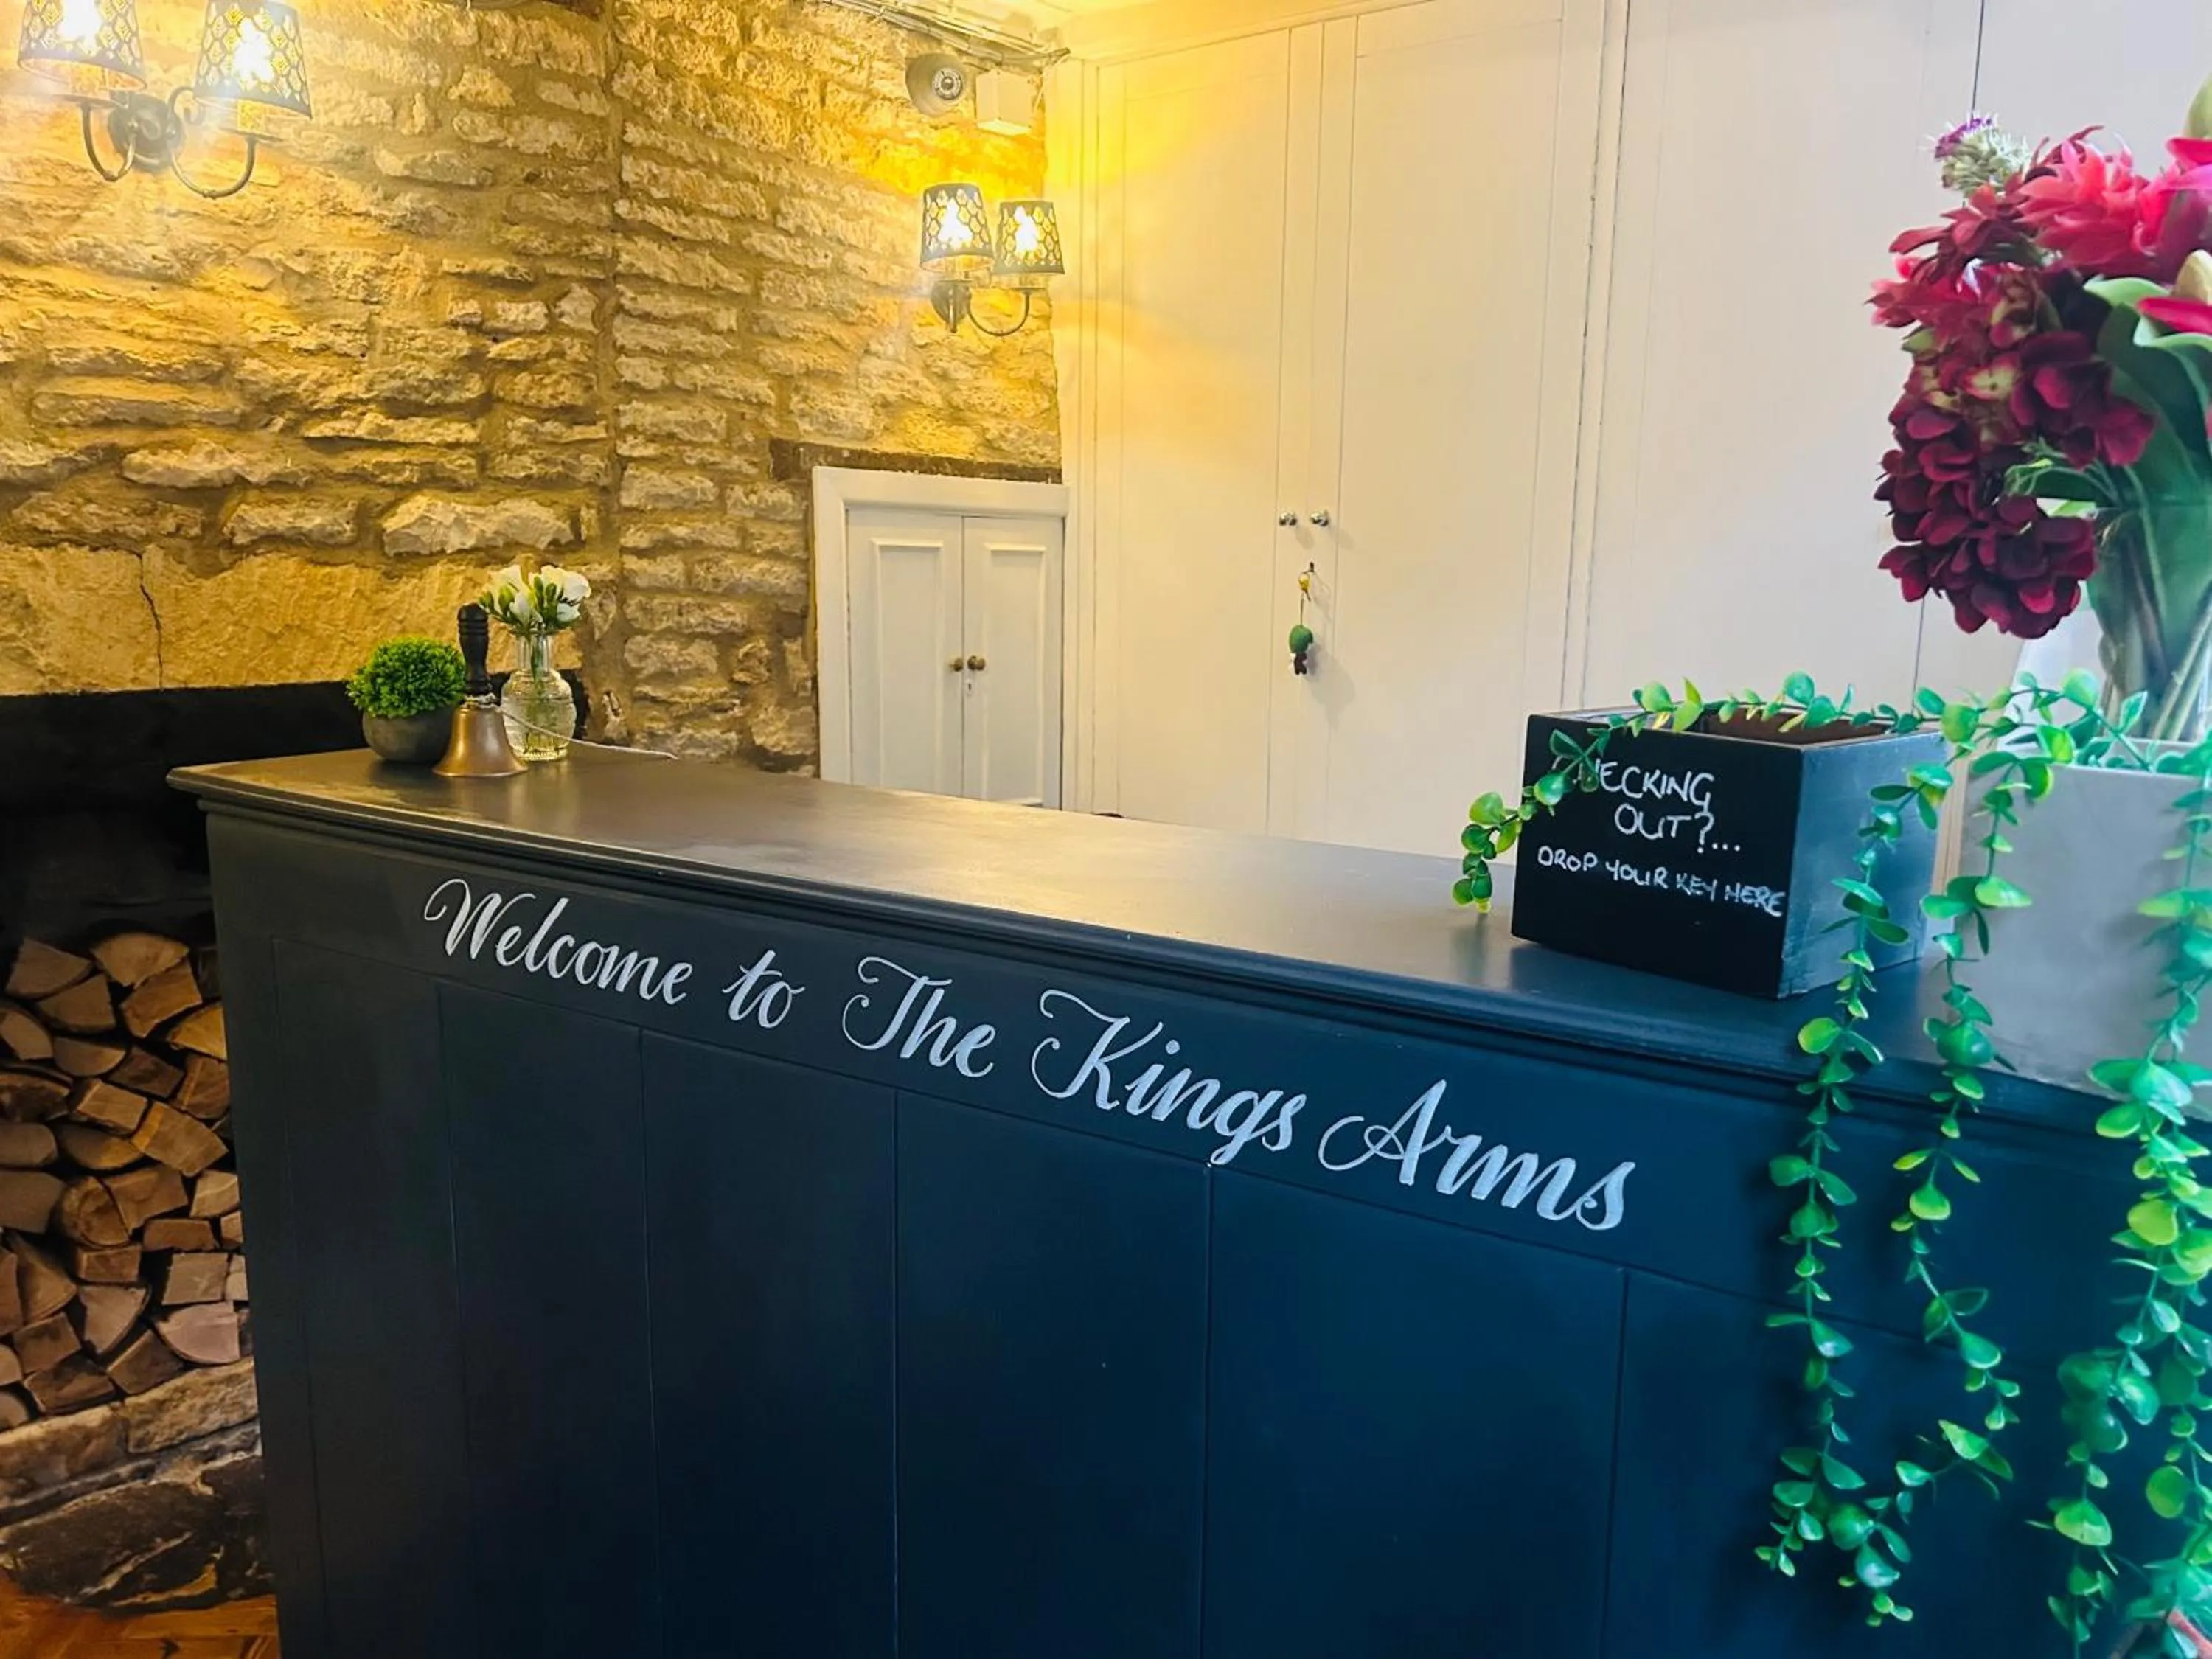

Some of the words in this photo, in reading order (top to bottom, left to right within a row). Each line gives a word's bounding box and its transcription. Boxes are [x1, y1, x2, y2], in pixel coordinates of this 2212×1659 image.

[1551, 754, 1714, 813] ECKING
[1614, 803, 1741, 853] OUT?...
[1537, 845, 1598, 872] DROP
[1605, 859, 1669, 889] YOUR
[1676, 872, 1717, 902] KEY
[1724, 883, 1786, 917] HERE
[424, 878, 693, 1005] Welcome
[721, 949, 805, 1029] to
[841, 956, 997, 1078] The
[1032, 989, 1307, 1166] Kings
[1318, 1079, 1636, 1231] Arms
